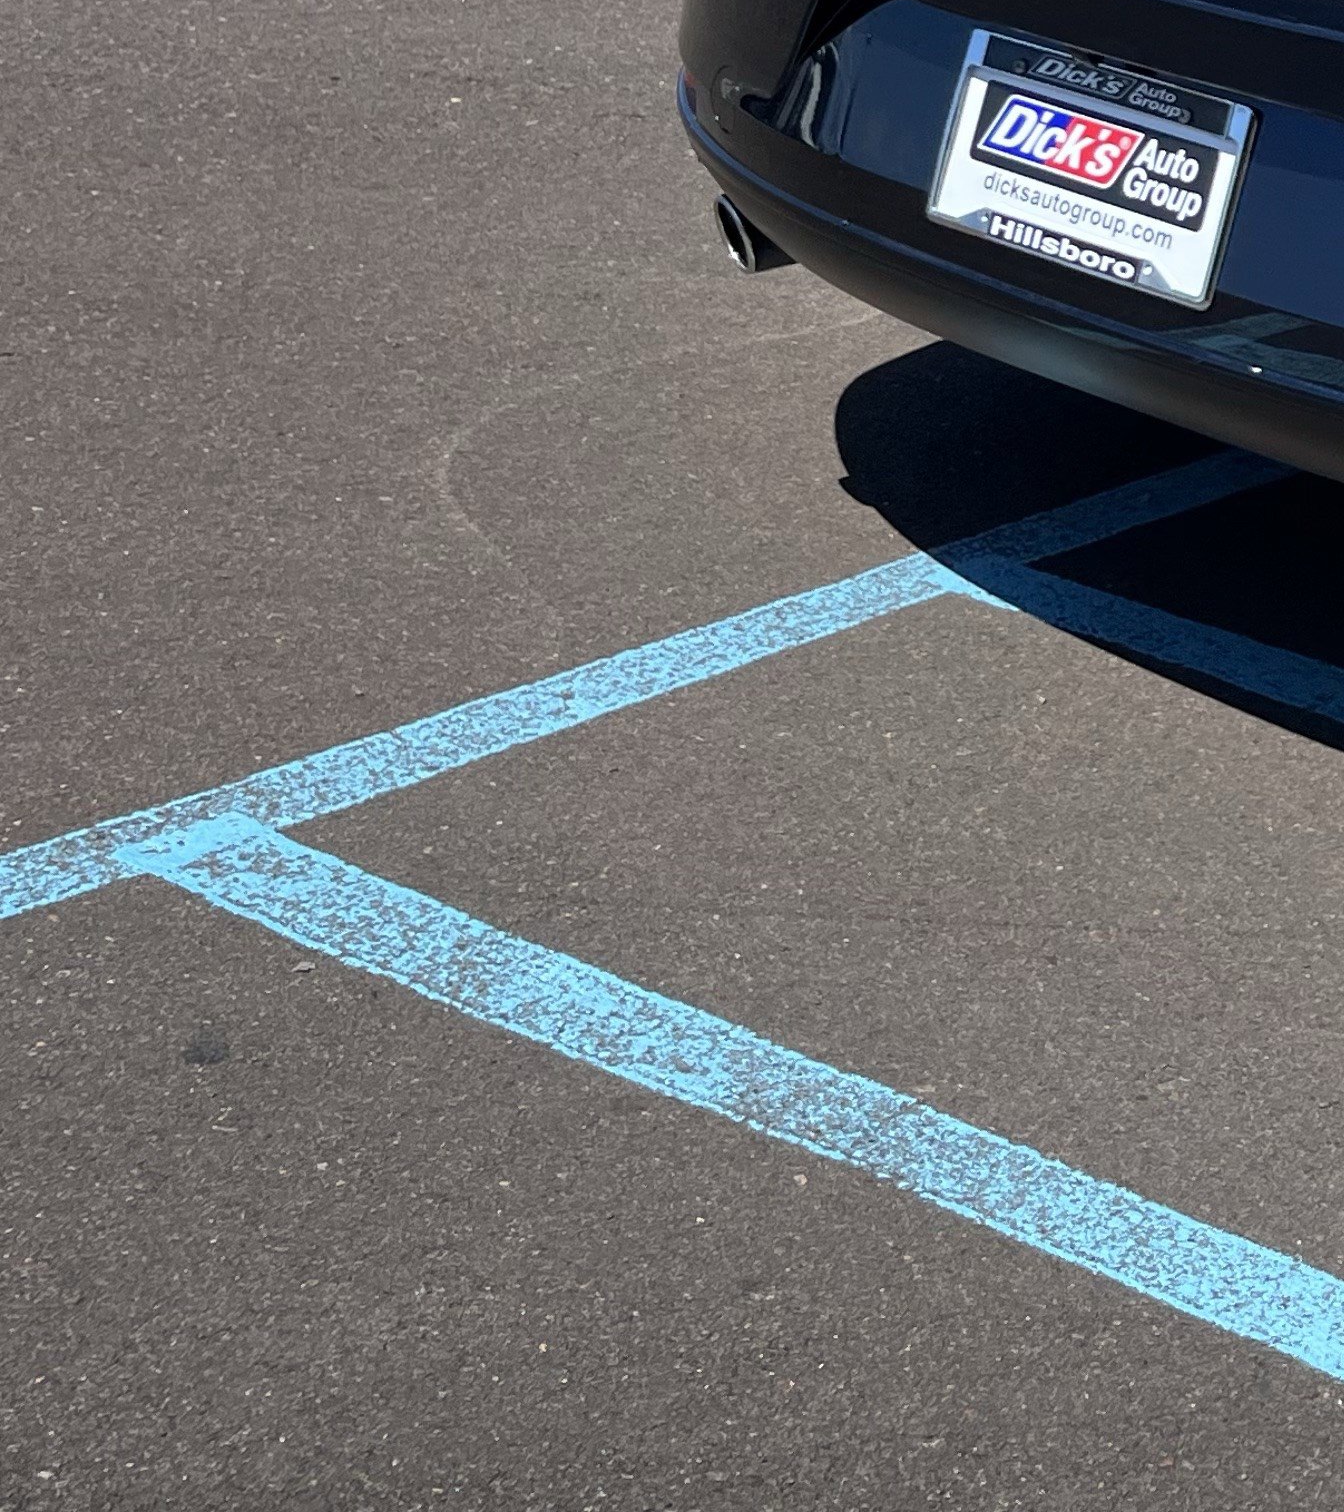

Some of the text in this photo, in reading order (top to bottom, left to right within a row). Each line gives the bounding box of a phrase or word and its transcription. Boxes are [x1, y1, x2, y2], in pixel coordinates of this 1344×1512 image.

[1036, 58, 1125, 95] Dick's
[1136, 82, 1178, 105] Auto
[1127, 91, 1183, 118] Group
[989, 102, 1125, 178] Dick's
[1132, 138, 1200, 184] Auto
[983, 171, 1173, 250] dicksautogroup.com
[1122, 164, 1203, 222] Group
[988, 214, 1137, 281] Hillsboro
